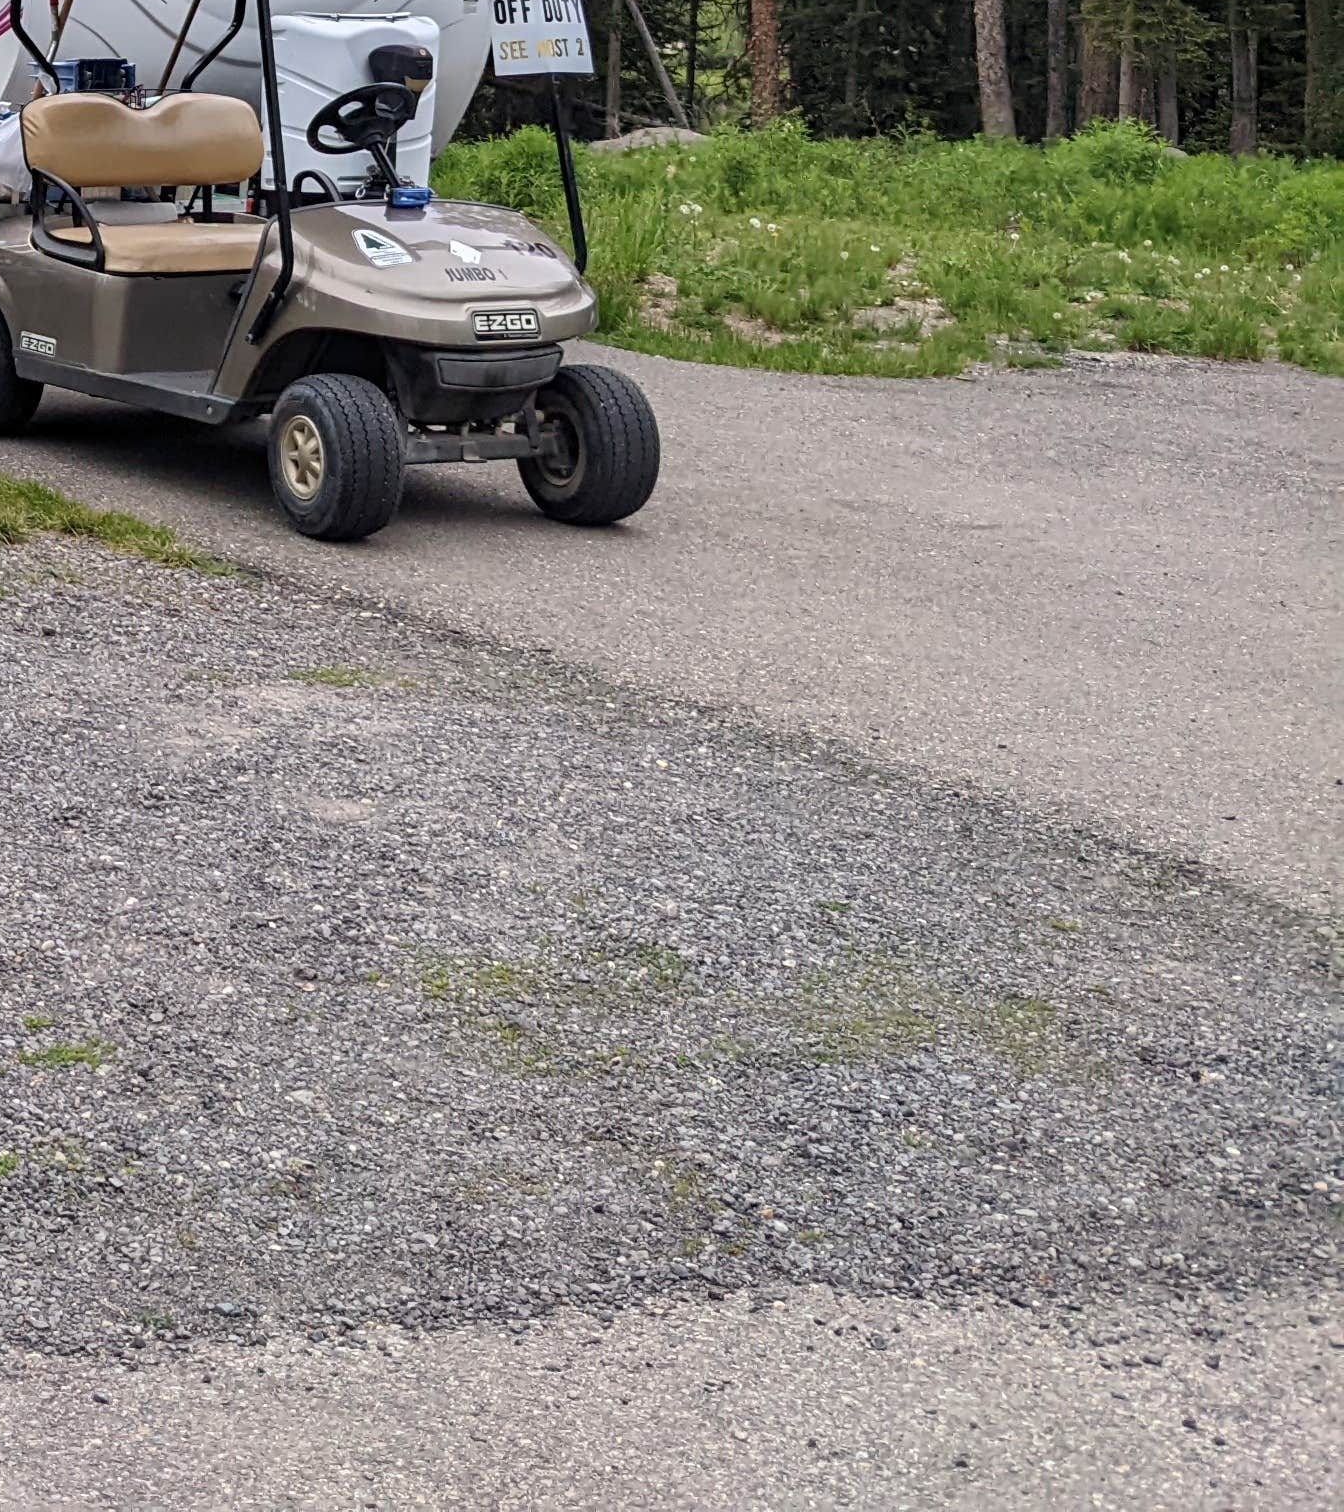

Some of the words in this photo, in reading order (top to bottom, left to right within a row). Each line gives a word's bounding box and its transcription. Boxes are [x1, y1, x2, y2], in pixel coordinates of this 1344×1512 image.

[499, 41, 529, 60] SEE
[537, 38, 569, 58] OST
[575, 38, 585, 56] 2
[444, 267, 497, 282] JUMBO
